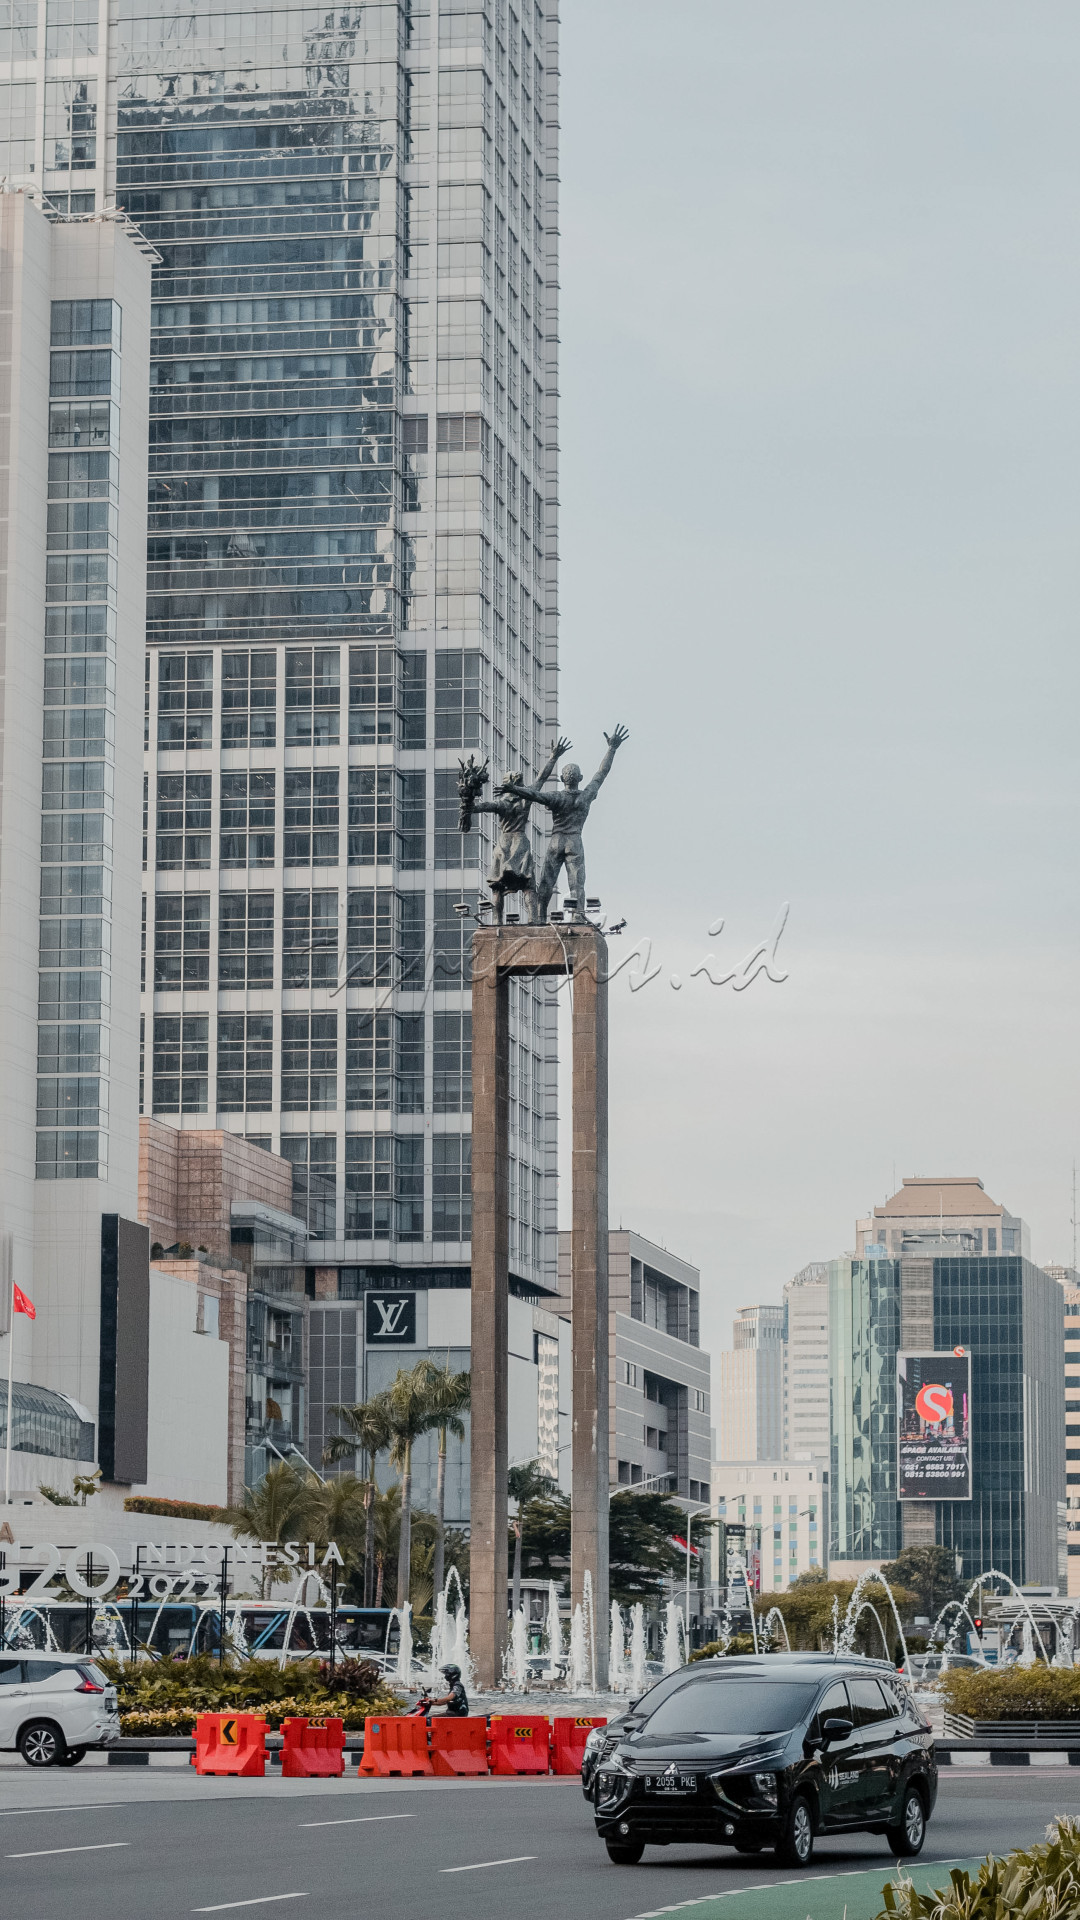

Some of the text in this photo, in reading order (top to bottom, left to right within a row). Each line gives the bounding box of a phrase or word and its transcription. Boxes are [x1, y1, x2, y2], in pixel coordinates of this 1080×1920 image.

[901, 1446, 968, 1454] SPACE AVAILABLE
[946, 1463, 965, 1471] 7017
[128, 1541, 345, 1566] INDONESIA
[127, 1573, 221, 1598] 2022
[645, 1776, 696, 1787] B 2055 PKE
